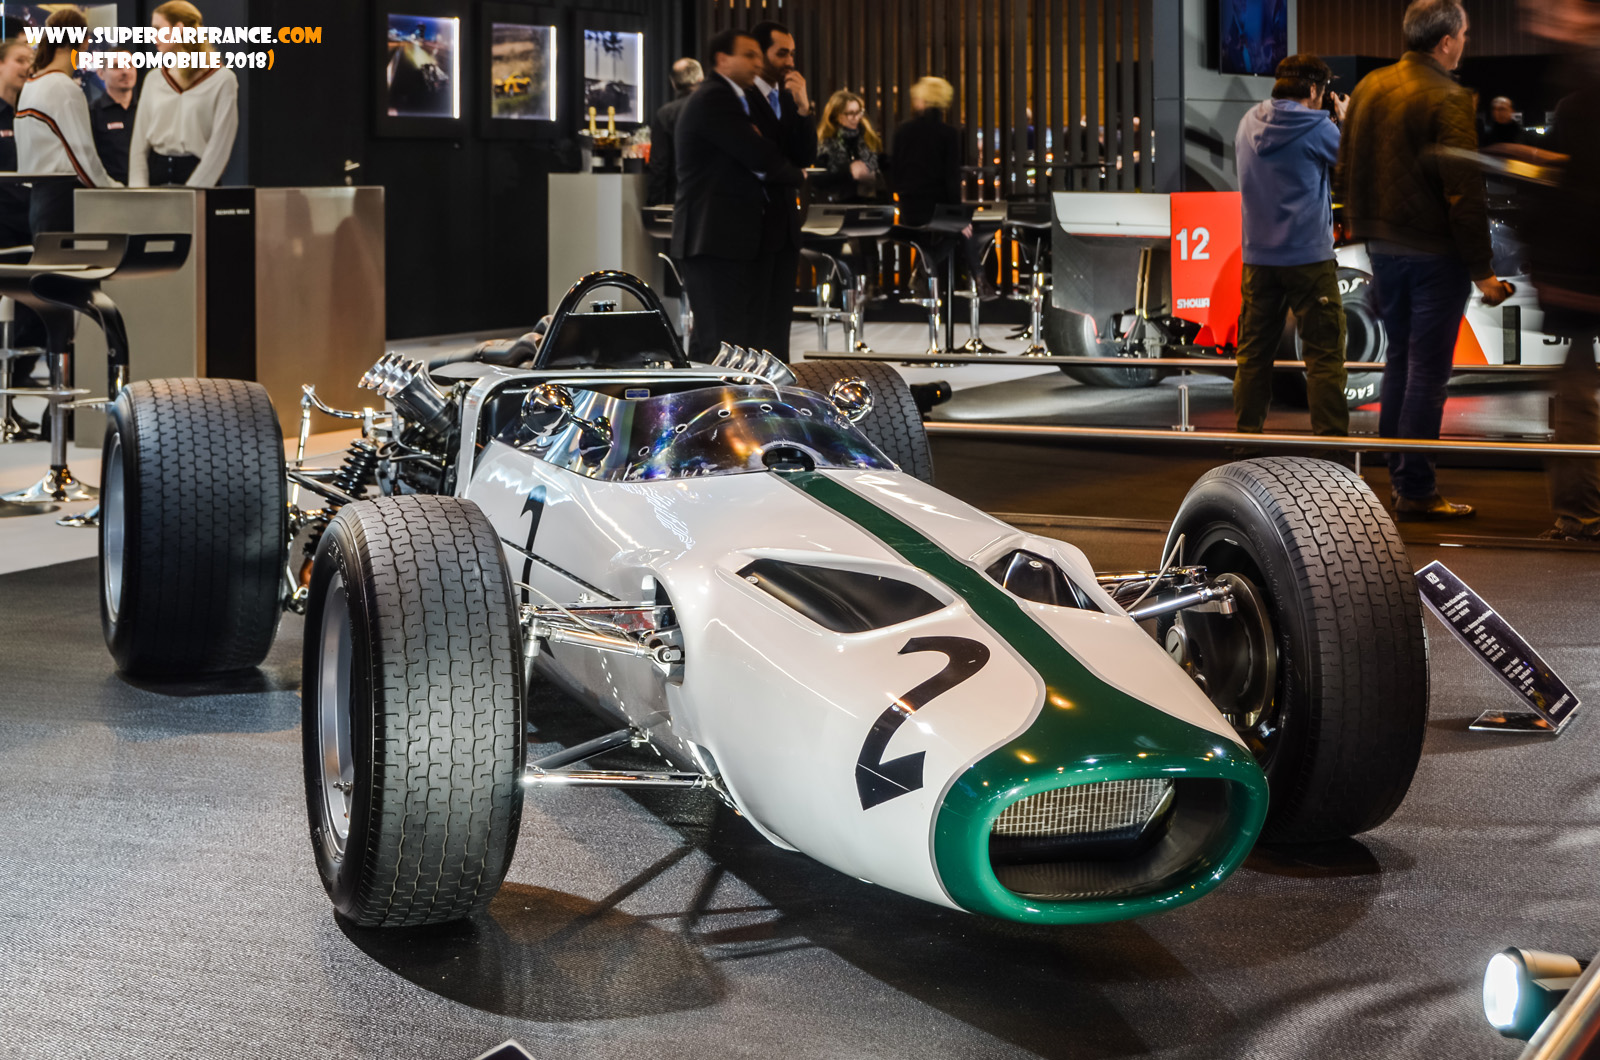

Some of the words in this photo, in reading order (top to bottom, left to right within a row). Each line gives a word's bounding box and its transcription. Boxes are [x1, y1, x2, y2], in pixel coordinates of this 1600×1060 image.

[1175, 226, 1211, 261] 12
[1176, 297, 1211, 309] SHOWA
[855, 635, 991, 811] 2
